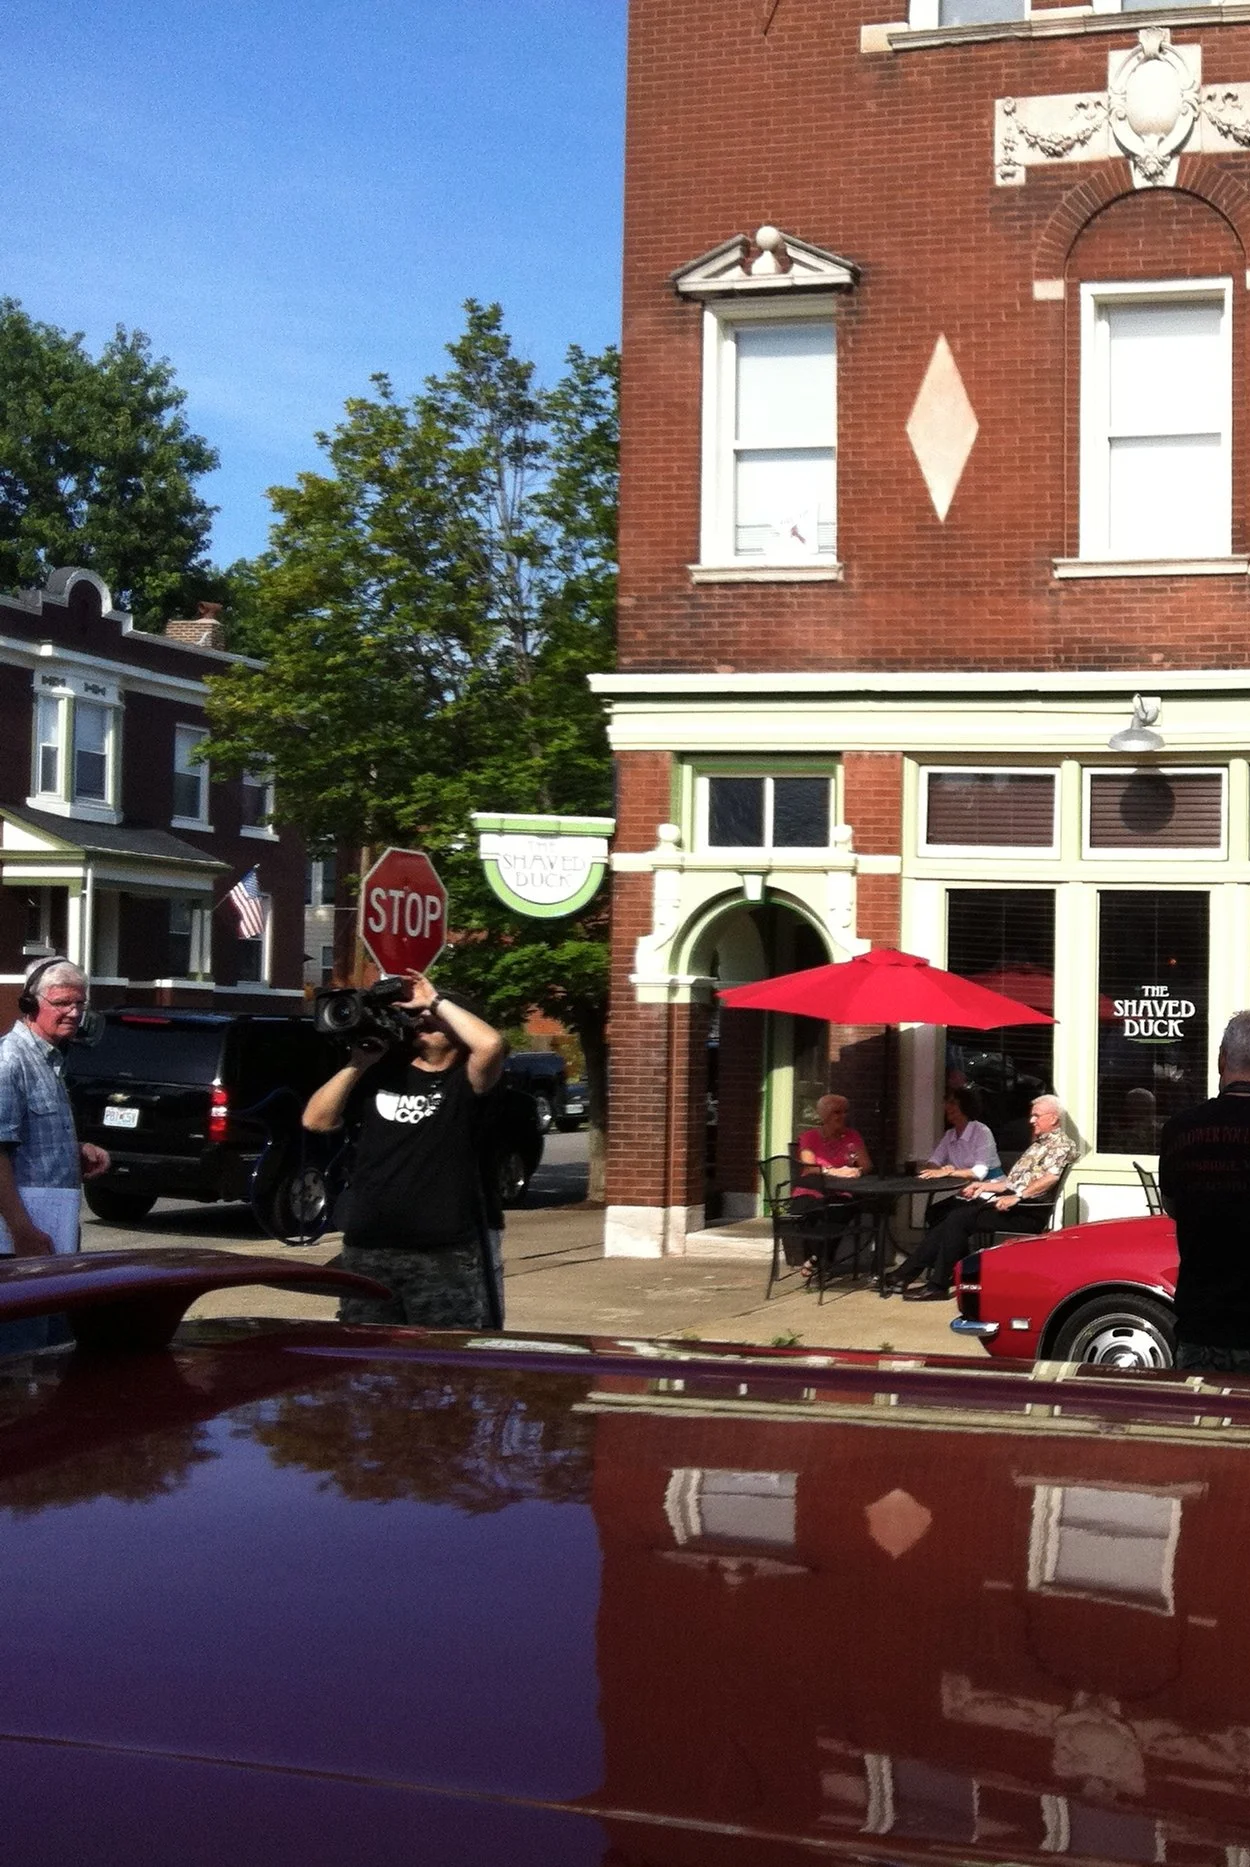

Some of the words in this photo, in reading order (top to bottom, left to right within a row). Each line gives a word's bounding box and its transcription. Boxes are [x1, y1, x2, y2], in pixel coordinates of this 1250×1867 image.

[528, 841, 556, 853] THE
[502, 853, 586, 872] SHAVED
[515, 872, 572, 888] DUCK
[368, 887, 441, 938] STOP
[1141, 985, 1170, 997] THE
[1113, 999, 1196, 1018] SHAVED
[1123, 1019, 1184, 1037] DUCK
